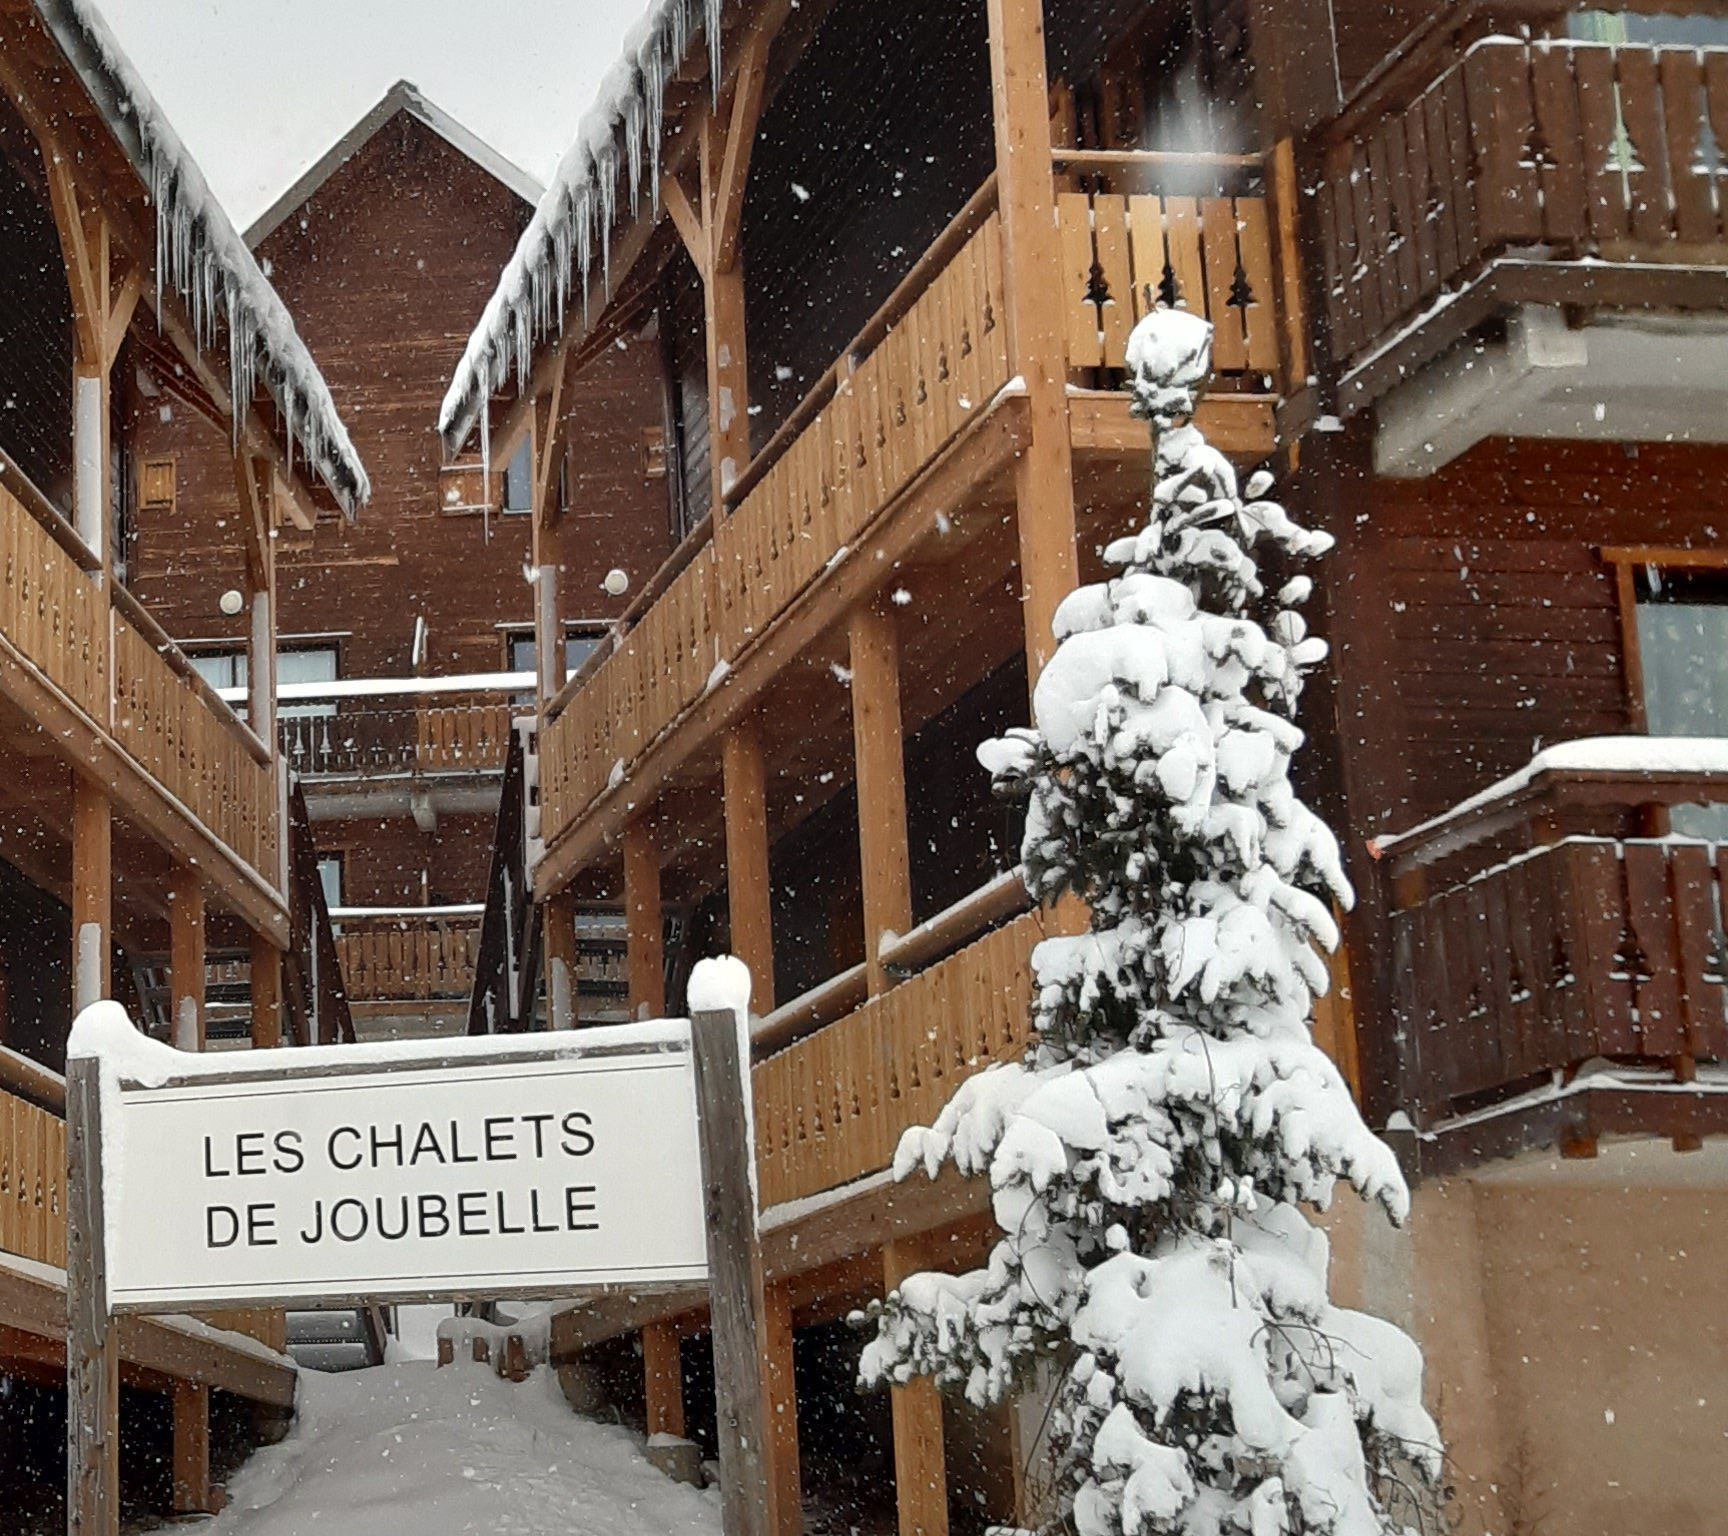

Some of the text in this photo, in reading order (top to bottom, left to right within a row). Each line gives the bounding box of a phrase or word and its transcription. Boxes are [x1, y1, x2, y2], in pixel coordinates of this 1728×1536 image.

[203, 1111, 595, 1178] LES CHALETS
[206, 1185, 600, 1249] DE JOUBELLE
